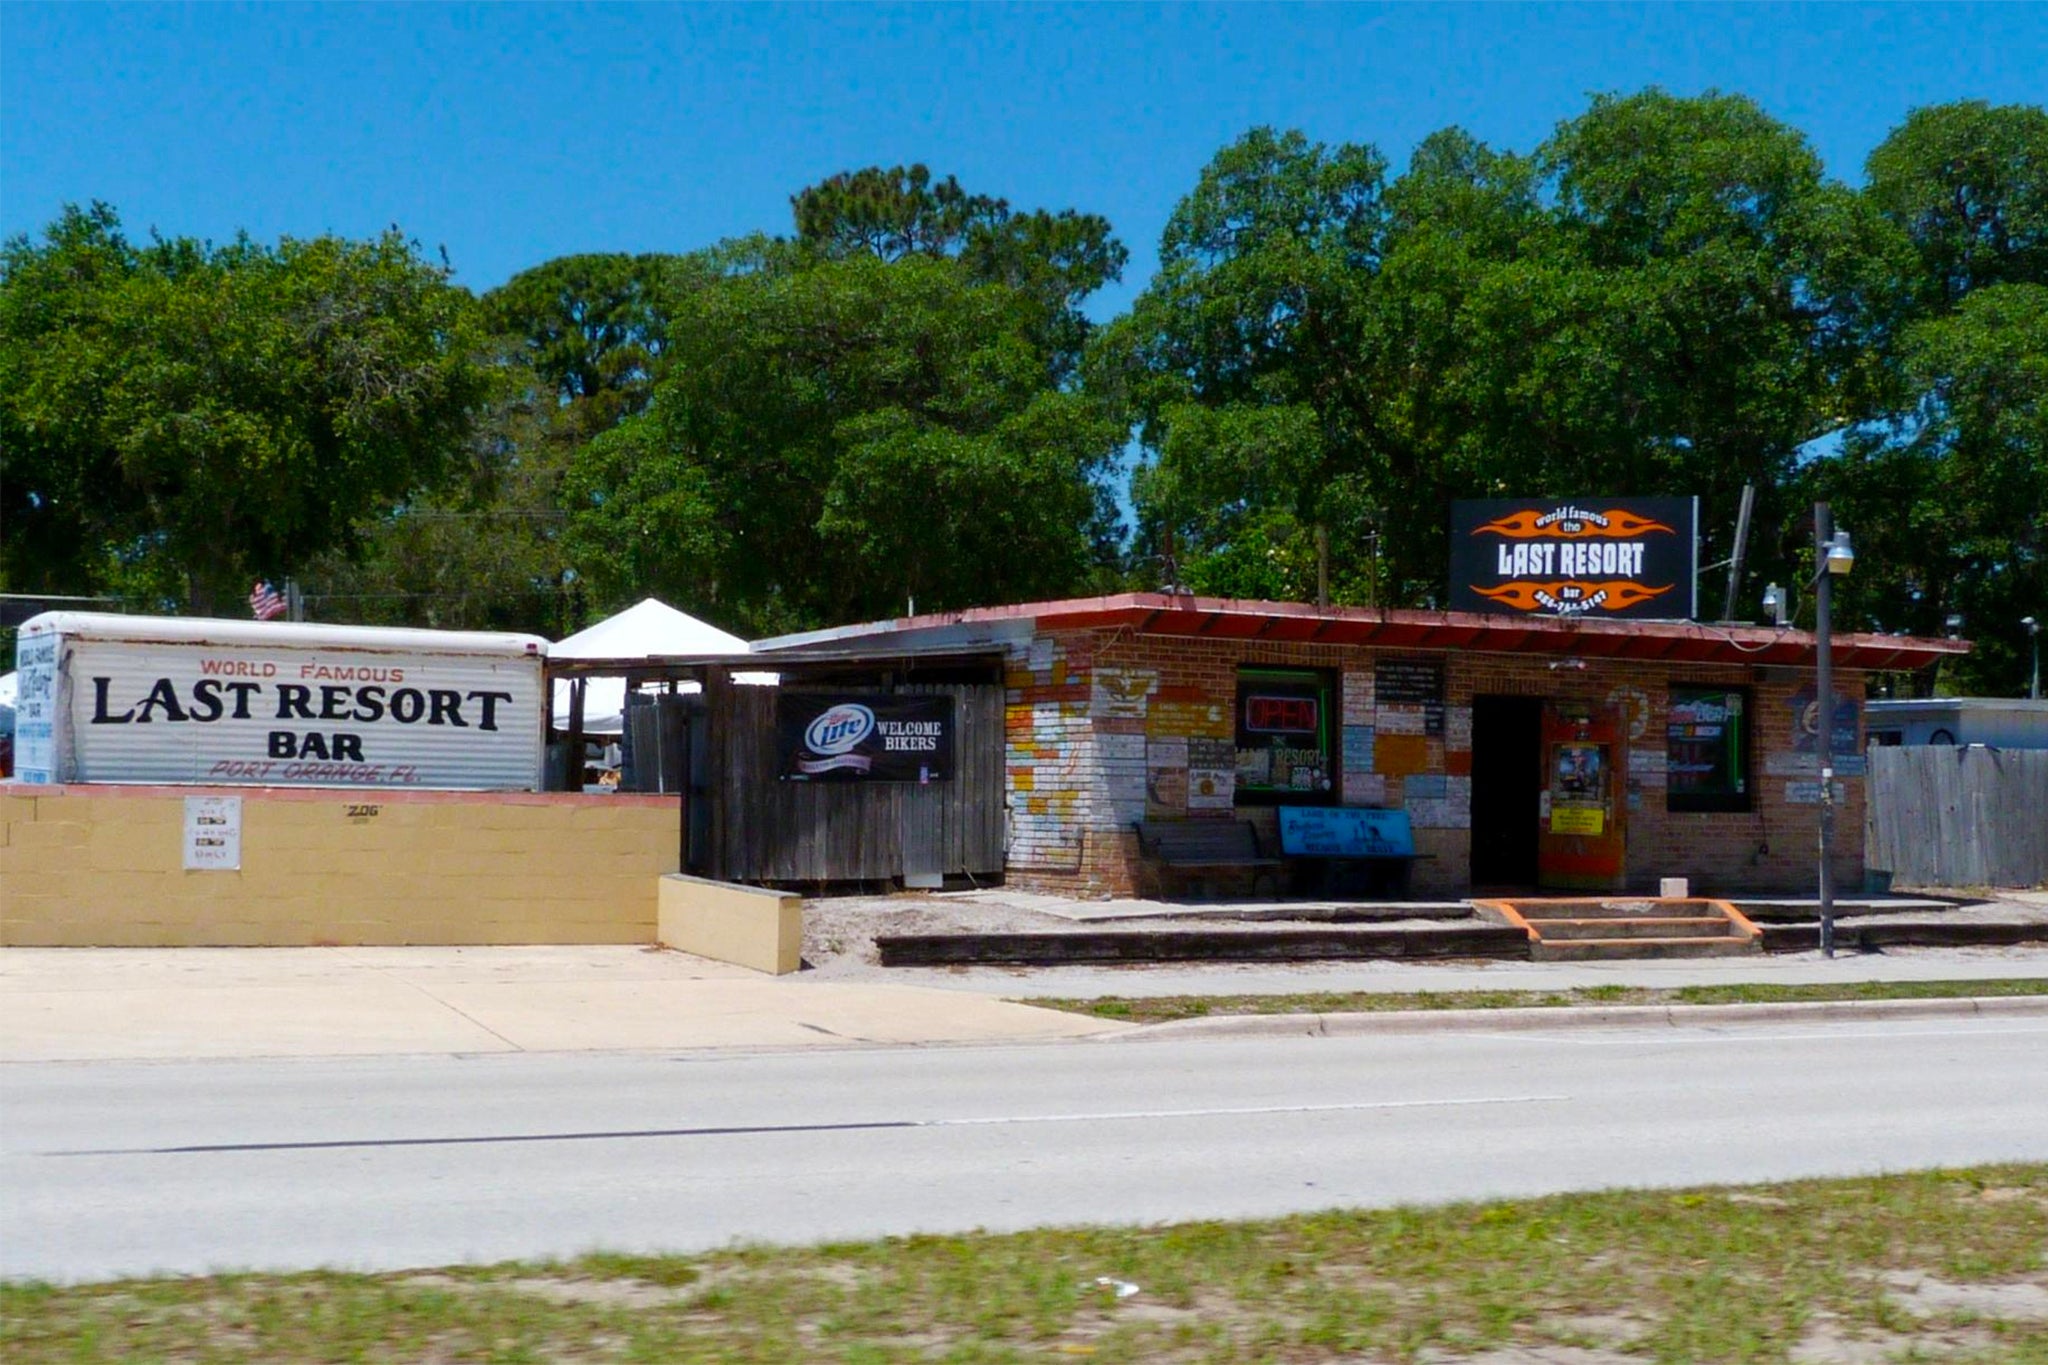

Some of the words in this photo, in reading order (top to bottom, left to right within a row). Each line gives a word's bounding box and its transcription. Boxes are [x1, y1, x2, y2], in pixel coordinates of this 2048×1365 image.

[1535, 507, 1568, 527] world
[1568, 506, 1609, 526] famous
[1498, 543, 1555, 578] LAST
[1560, 542, 1645, 579] RESORT
[201, 659, 276, 678] WORLD
[300, 663, 405, 683] FAMOUS
[91, 676, 261, 725] LAST
[276, 684, 512, 731] RESORT
[1251, 699, 1317, 730] OPEN
[819, 718, 862, 746] Lite
[877, 721, 942, 736] WELCOME
[268, 731, 365, 762] BAR
[885, 737, 936, 751] BIKERS
[209, 760, 275, 778] PORT
[1275, 748, 1321, 767] RESORT
